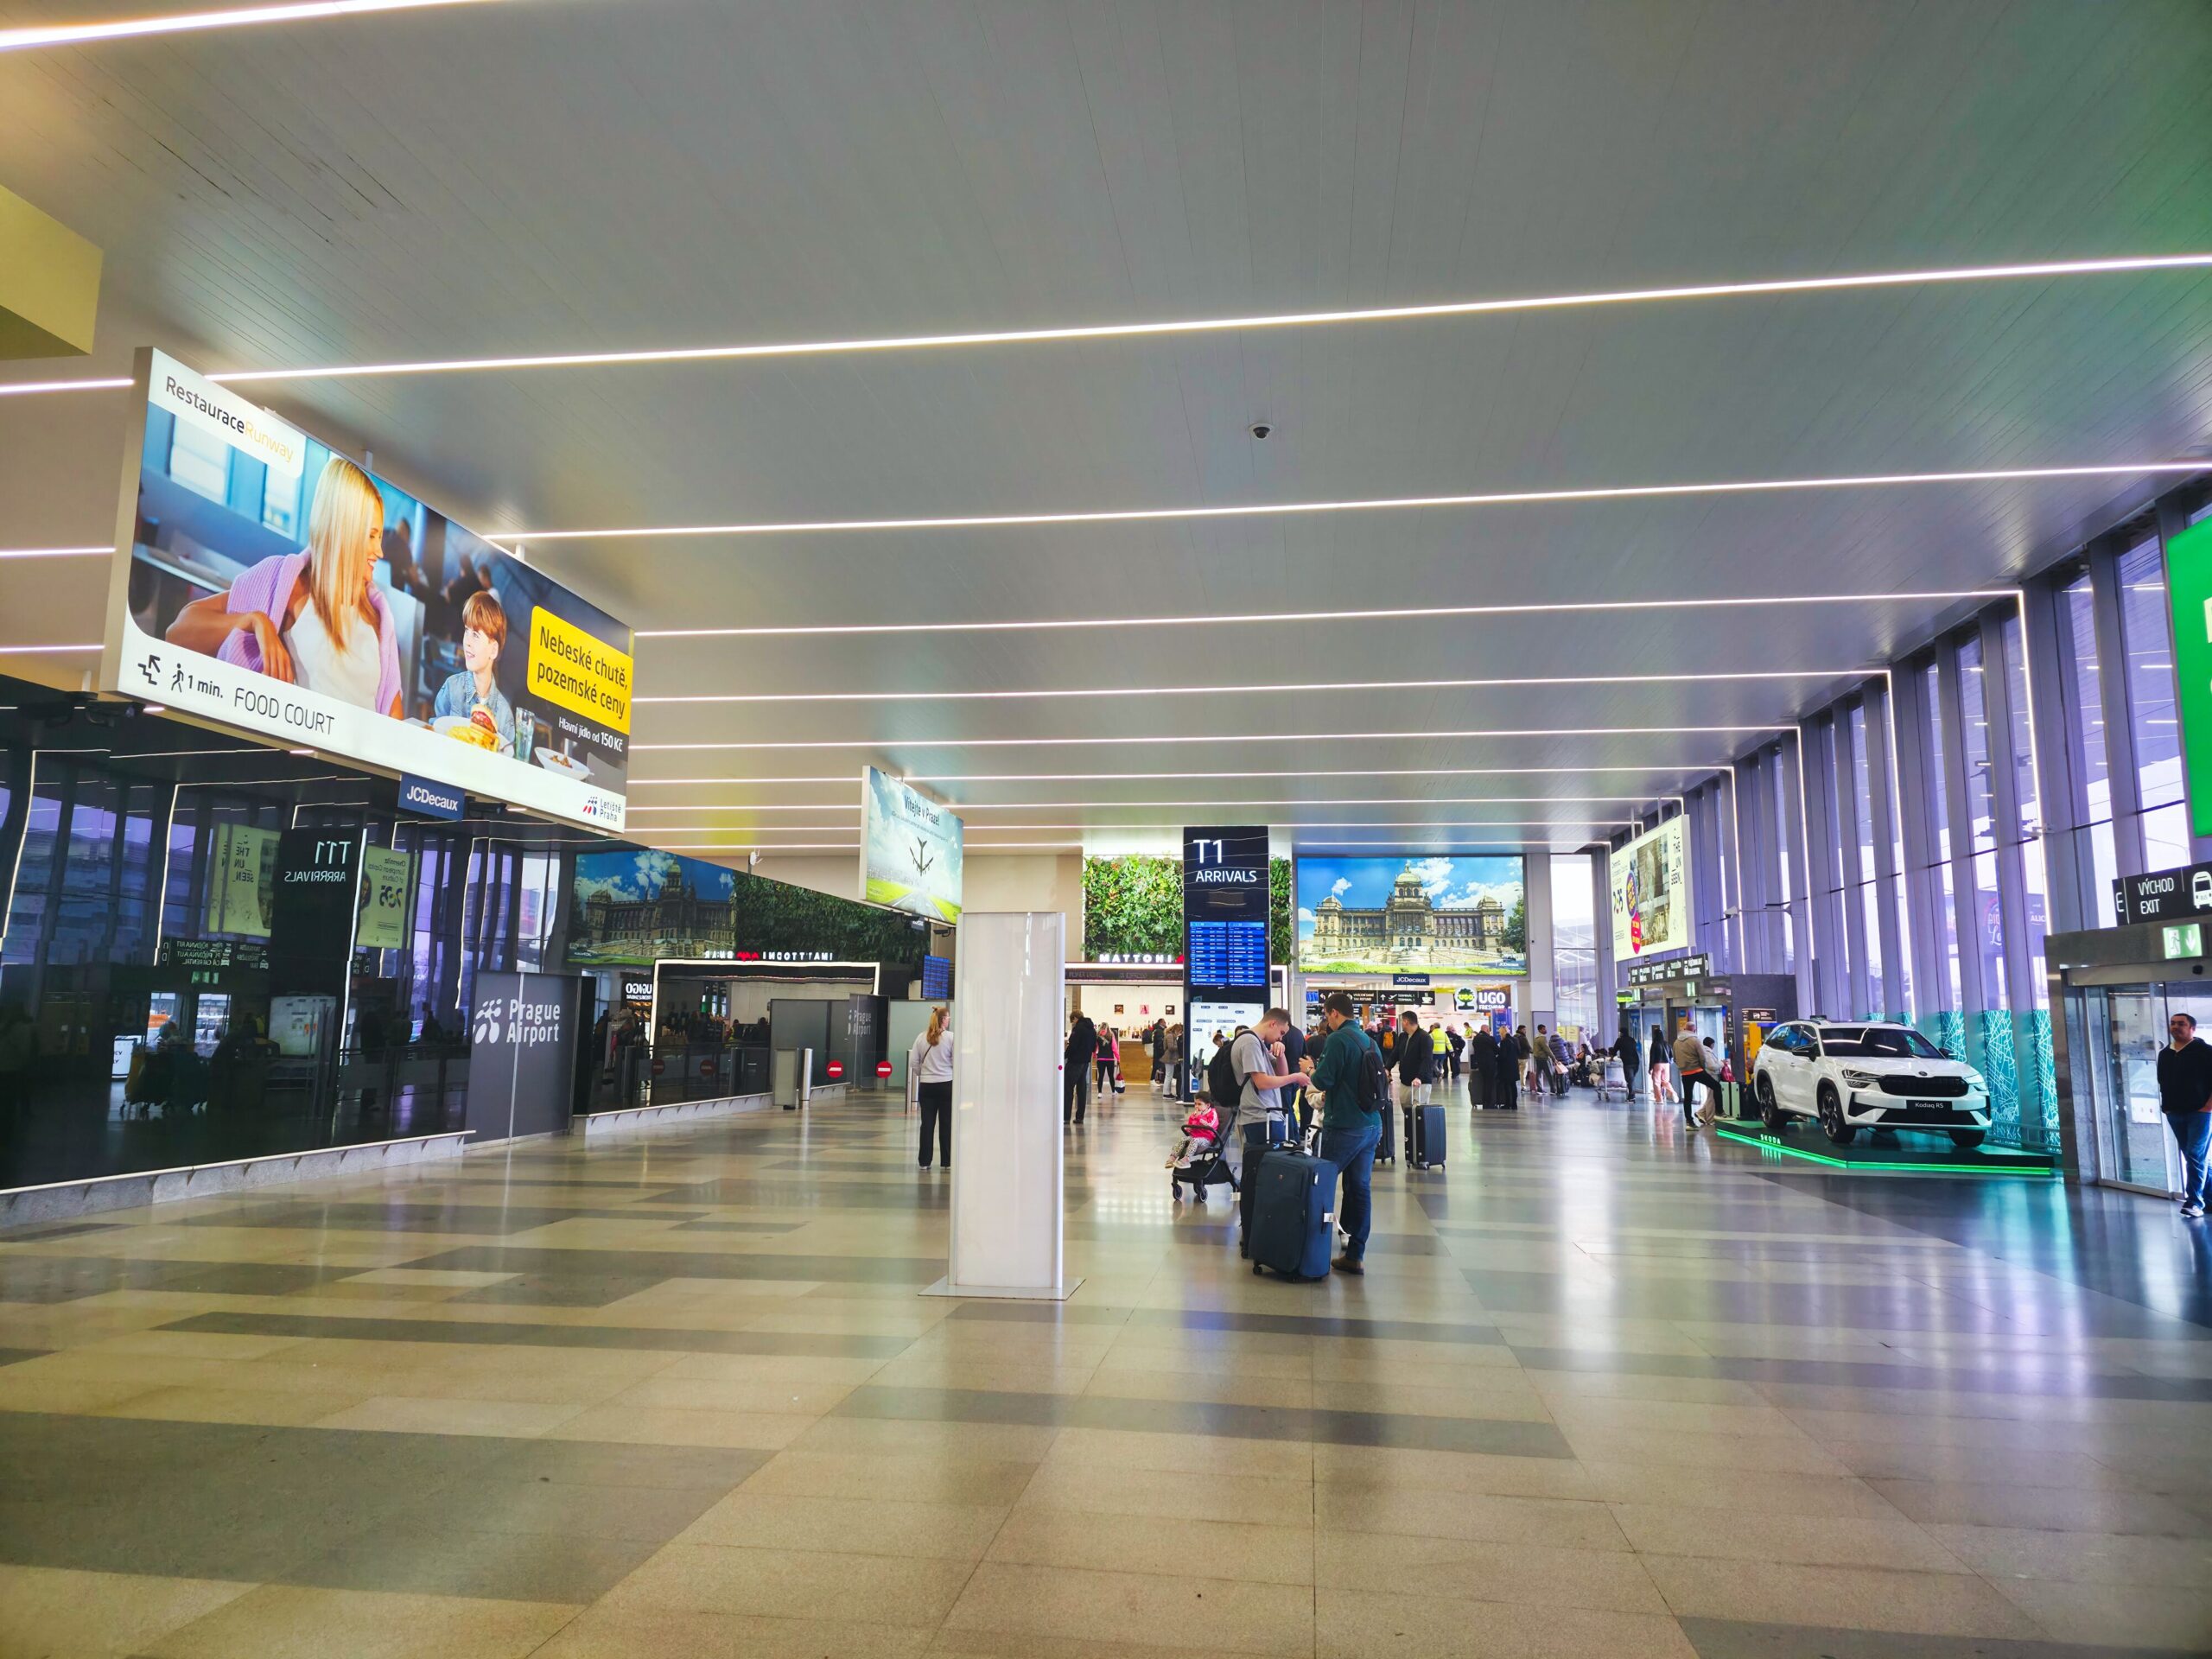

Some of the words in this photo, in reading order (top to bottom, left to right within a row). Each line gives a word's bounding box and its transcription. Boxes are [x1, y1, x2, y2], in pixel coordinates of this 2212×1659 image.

[539, 626, 592, 671] Nebeské
[594, 658, 628, 690] chutě,
[188, 675, 194, 690] 1
[197, 680, 223, 698] min.
[537, 662, 597, 703] pozemské
[600, 692, 626, 720] ceny
[234, 687, 279, 719] FOOD
[284, 703, 335, 734] COURT
[558, 716, 579, 732] Hlavní
[578, 722, 591, 740] jídlo
[592, 733, 600, 743] od
[601, 731, 613, 748] 150
[613, 736, 623, 753] Kč
[406, 785, 459, 811] JCDecaux
[600, 798, 621, 814] Letiště
[600, 809, 618, 822] Praha
[1193, 839, 1223, 864] T1
[1195, 870, 1257, 883] ARRIVALS
[2138, 878, 2175, 896] VÝCHOD
[2115, 892, 2125, 912] E
[2140, 899, 2160, 915] EXIT
[1099, 954, 1172, 963] MATTONI
[1478, 992, 1506, 1004] UGO
[509, 999, 561, 1025] Prague
[506, 1022, 560, 1047] Airport
